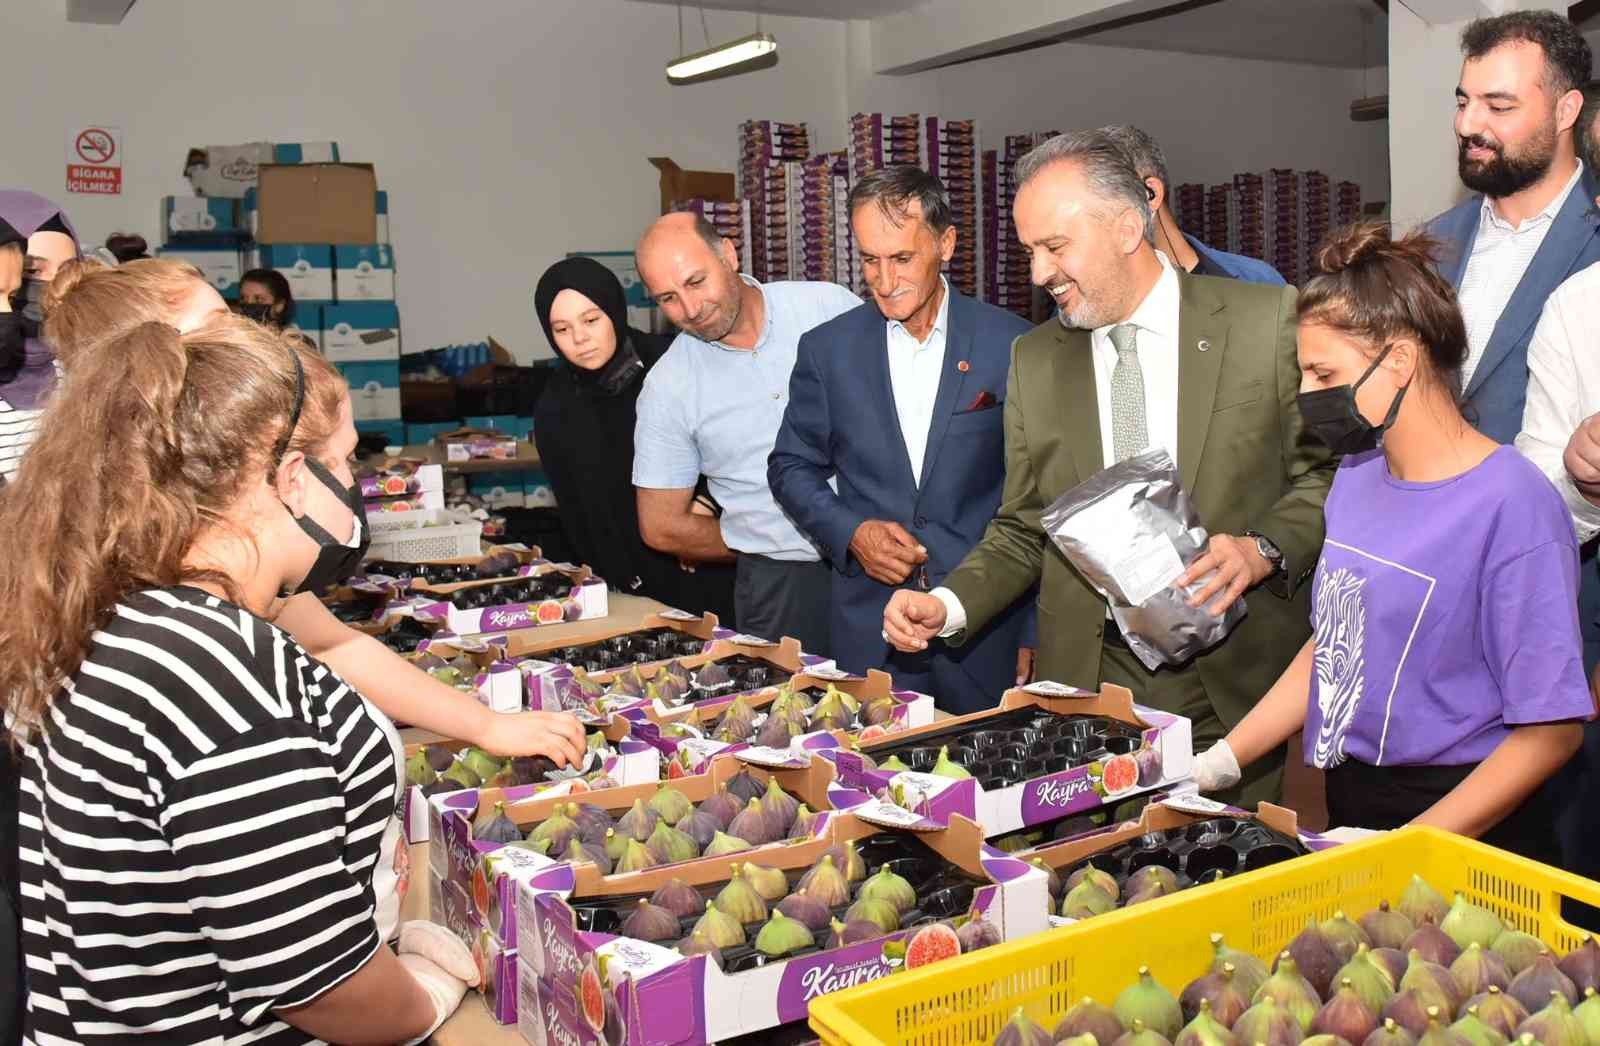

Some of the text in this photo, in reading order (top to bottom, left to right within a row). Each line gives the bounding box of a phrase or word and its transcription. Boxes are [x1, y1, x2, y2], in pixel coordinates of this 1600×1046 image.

[489, 610, 528, 628] Kayra
[1036, 779, 1089, 807] Kayra
[543, 918, 577, 973] Kayra
